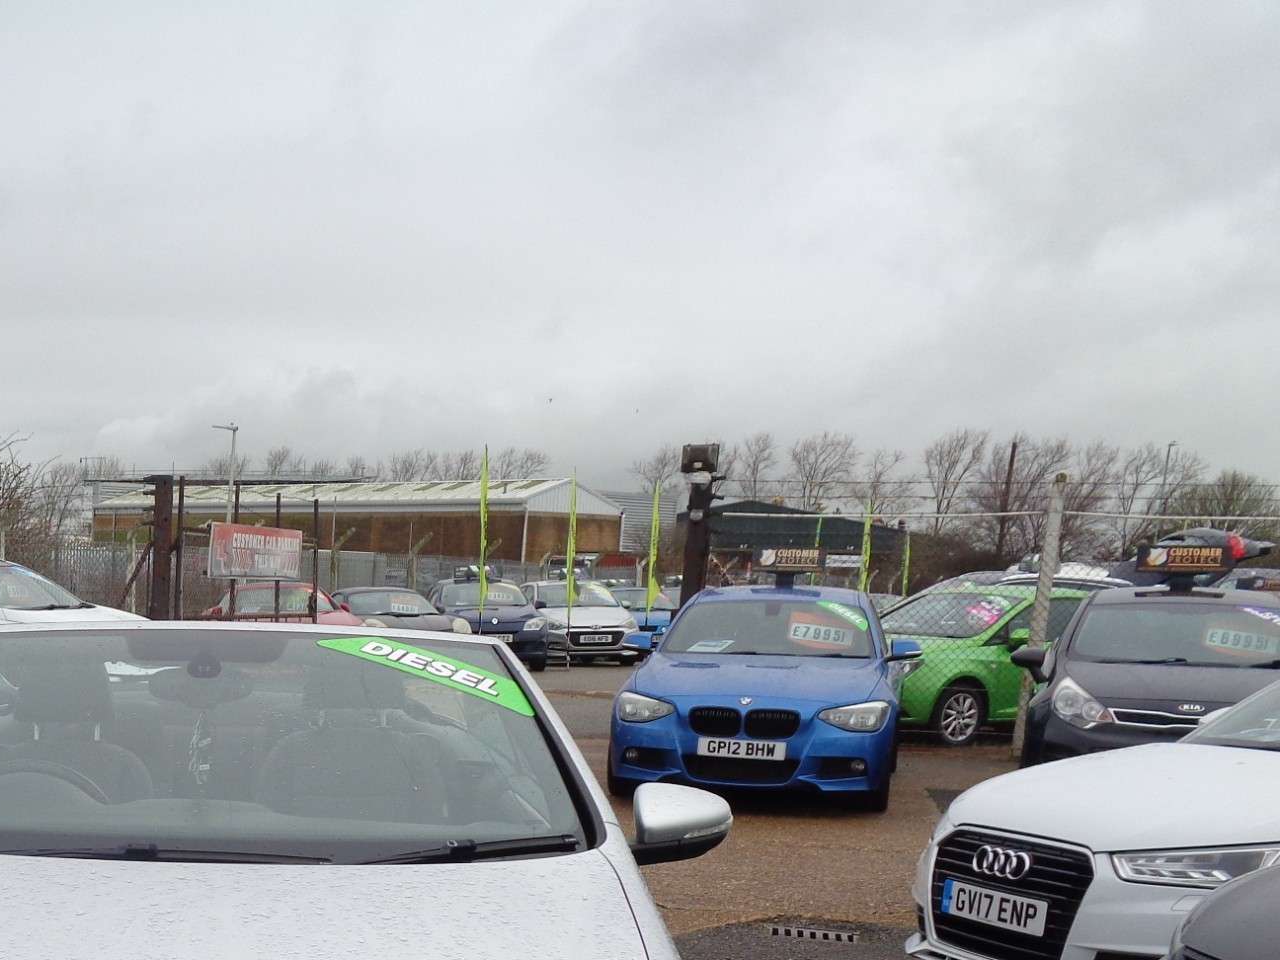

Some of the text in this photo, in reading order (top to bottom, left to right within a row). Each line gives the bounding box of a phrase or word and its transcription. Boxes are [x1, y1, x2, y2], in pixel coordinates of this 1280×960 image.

[777, 549, 820, 558] CUSTOMER
[1169, 547, 1223, 557] CUSTOMER
[1167, 556, 1221, 564] PROTECT
[360, 640, 499, 697] DIESEL
[1181, 703, 1202, 711] KIA
[707, 740, 776, 757] GP12 BHW
[955, 888, 1038, 928] GV17 ENP
